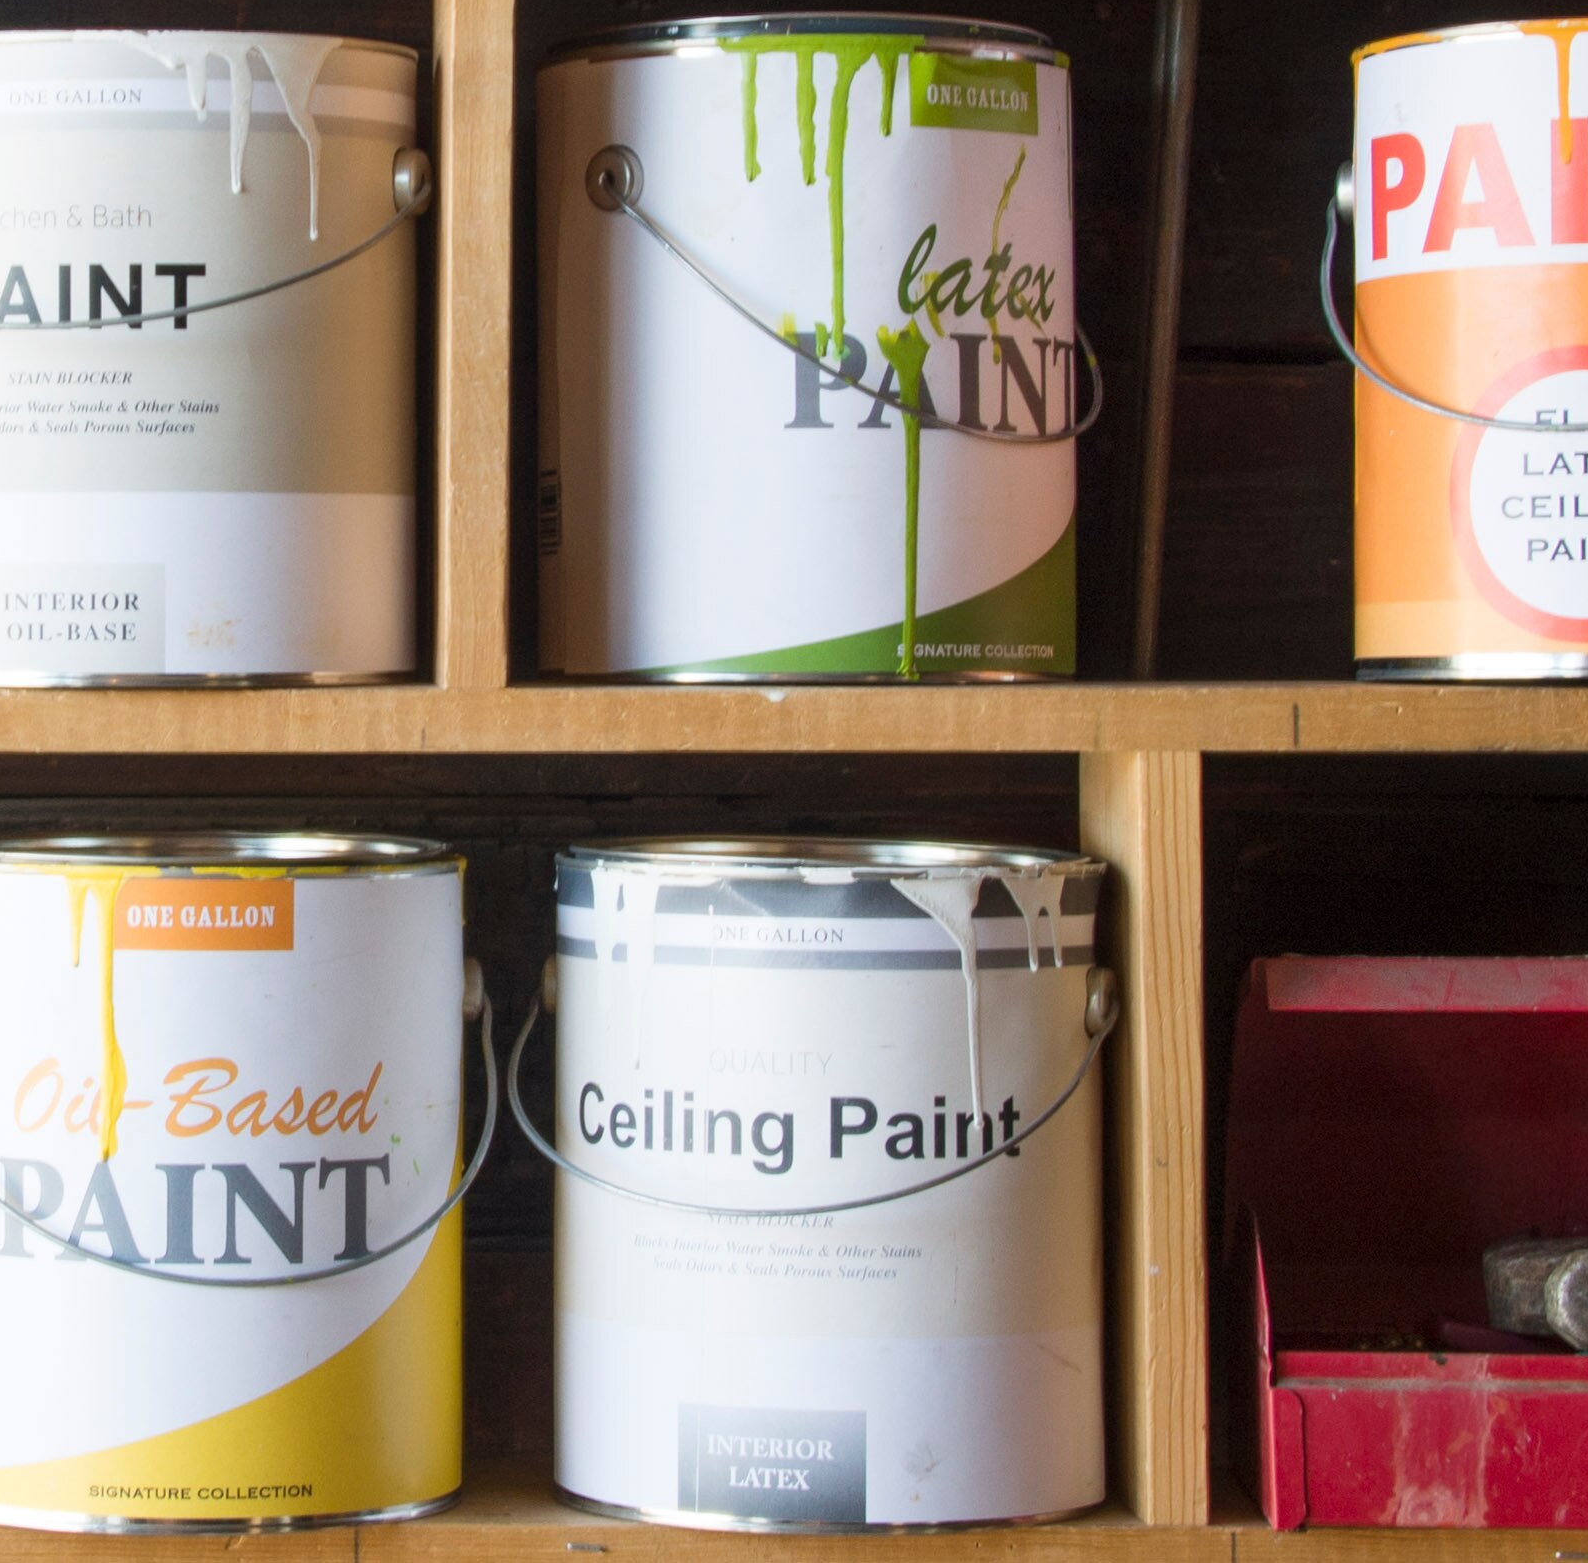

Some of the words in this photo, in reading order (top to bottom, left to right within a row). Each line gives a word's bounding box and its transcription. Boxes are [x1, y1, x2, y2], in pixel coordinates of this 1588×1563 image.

[9, 91, 49, 105] ONE
[56, 89, 142, 104] GALLON
[926, 83, 962, 107] ONE
[966, 87, 1030, 113] GALLON
[66, 204, 83, 229] &
[93, 204, 152, 228] Bath
[897, 223, 1056, 322] latex
[8, 372, 51, 385] STAIN
[56, 371, 133, 385] BLOCKER
[784, 331, 1073, 436] PAINT
[26, 401, 64, 413] Water
[69, 400, 114, 413] Smoke
[117, 400, 130, 412] &
[134, 400, 175, 413] Other
[178, 399, 220, 414] Stains
[28, 421, 41, 433] &
[46, 420, 80, 433] Seals
[83, 421, 131, 433] Porous
[135, 420, 196, 436] Surfaces
[4, 592, 140, 611] INTERIOR
[7, 622, 137, 642] OIL-BASE
[897, 643, 982, 658] SGNATURE
[984, 644, 1054, 659] COLLECTION
[127, 905, 173, 928] ONE
[180, 905, 276, 928] GALLON
[757, 927, 845, 943] GALLON
[709, 1048, 834, 1077] QUALITY
[13, 1057, 383, 1138] Oil-Based
[579, 1081, 794, 1175] Ceiling
[830, 1095, 1021, 1160] Paint
[725, 1240, 764, 1255] Water
[768, 1242, 813, 1257] Smoke
[818, 1244, 830, 1257] &
[835, 1243, 875, 1258] Other
[879, 1243, 923, 1259] Stains
[727, 1260, 739, 1274] &
[744, 1261, 780, 1276] Seals
[783, 1263, 832, 1278] Porous
[837, 1264, 899, 1282] Surfaces
[707, 1433, 834, 1460] INTERIOR
[729, 1466, 811, 1491] LATEX
[89, 1485, 192, 1500] SIGNATURE
[197, 1483, 313, 1500] COLLECTION
